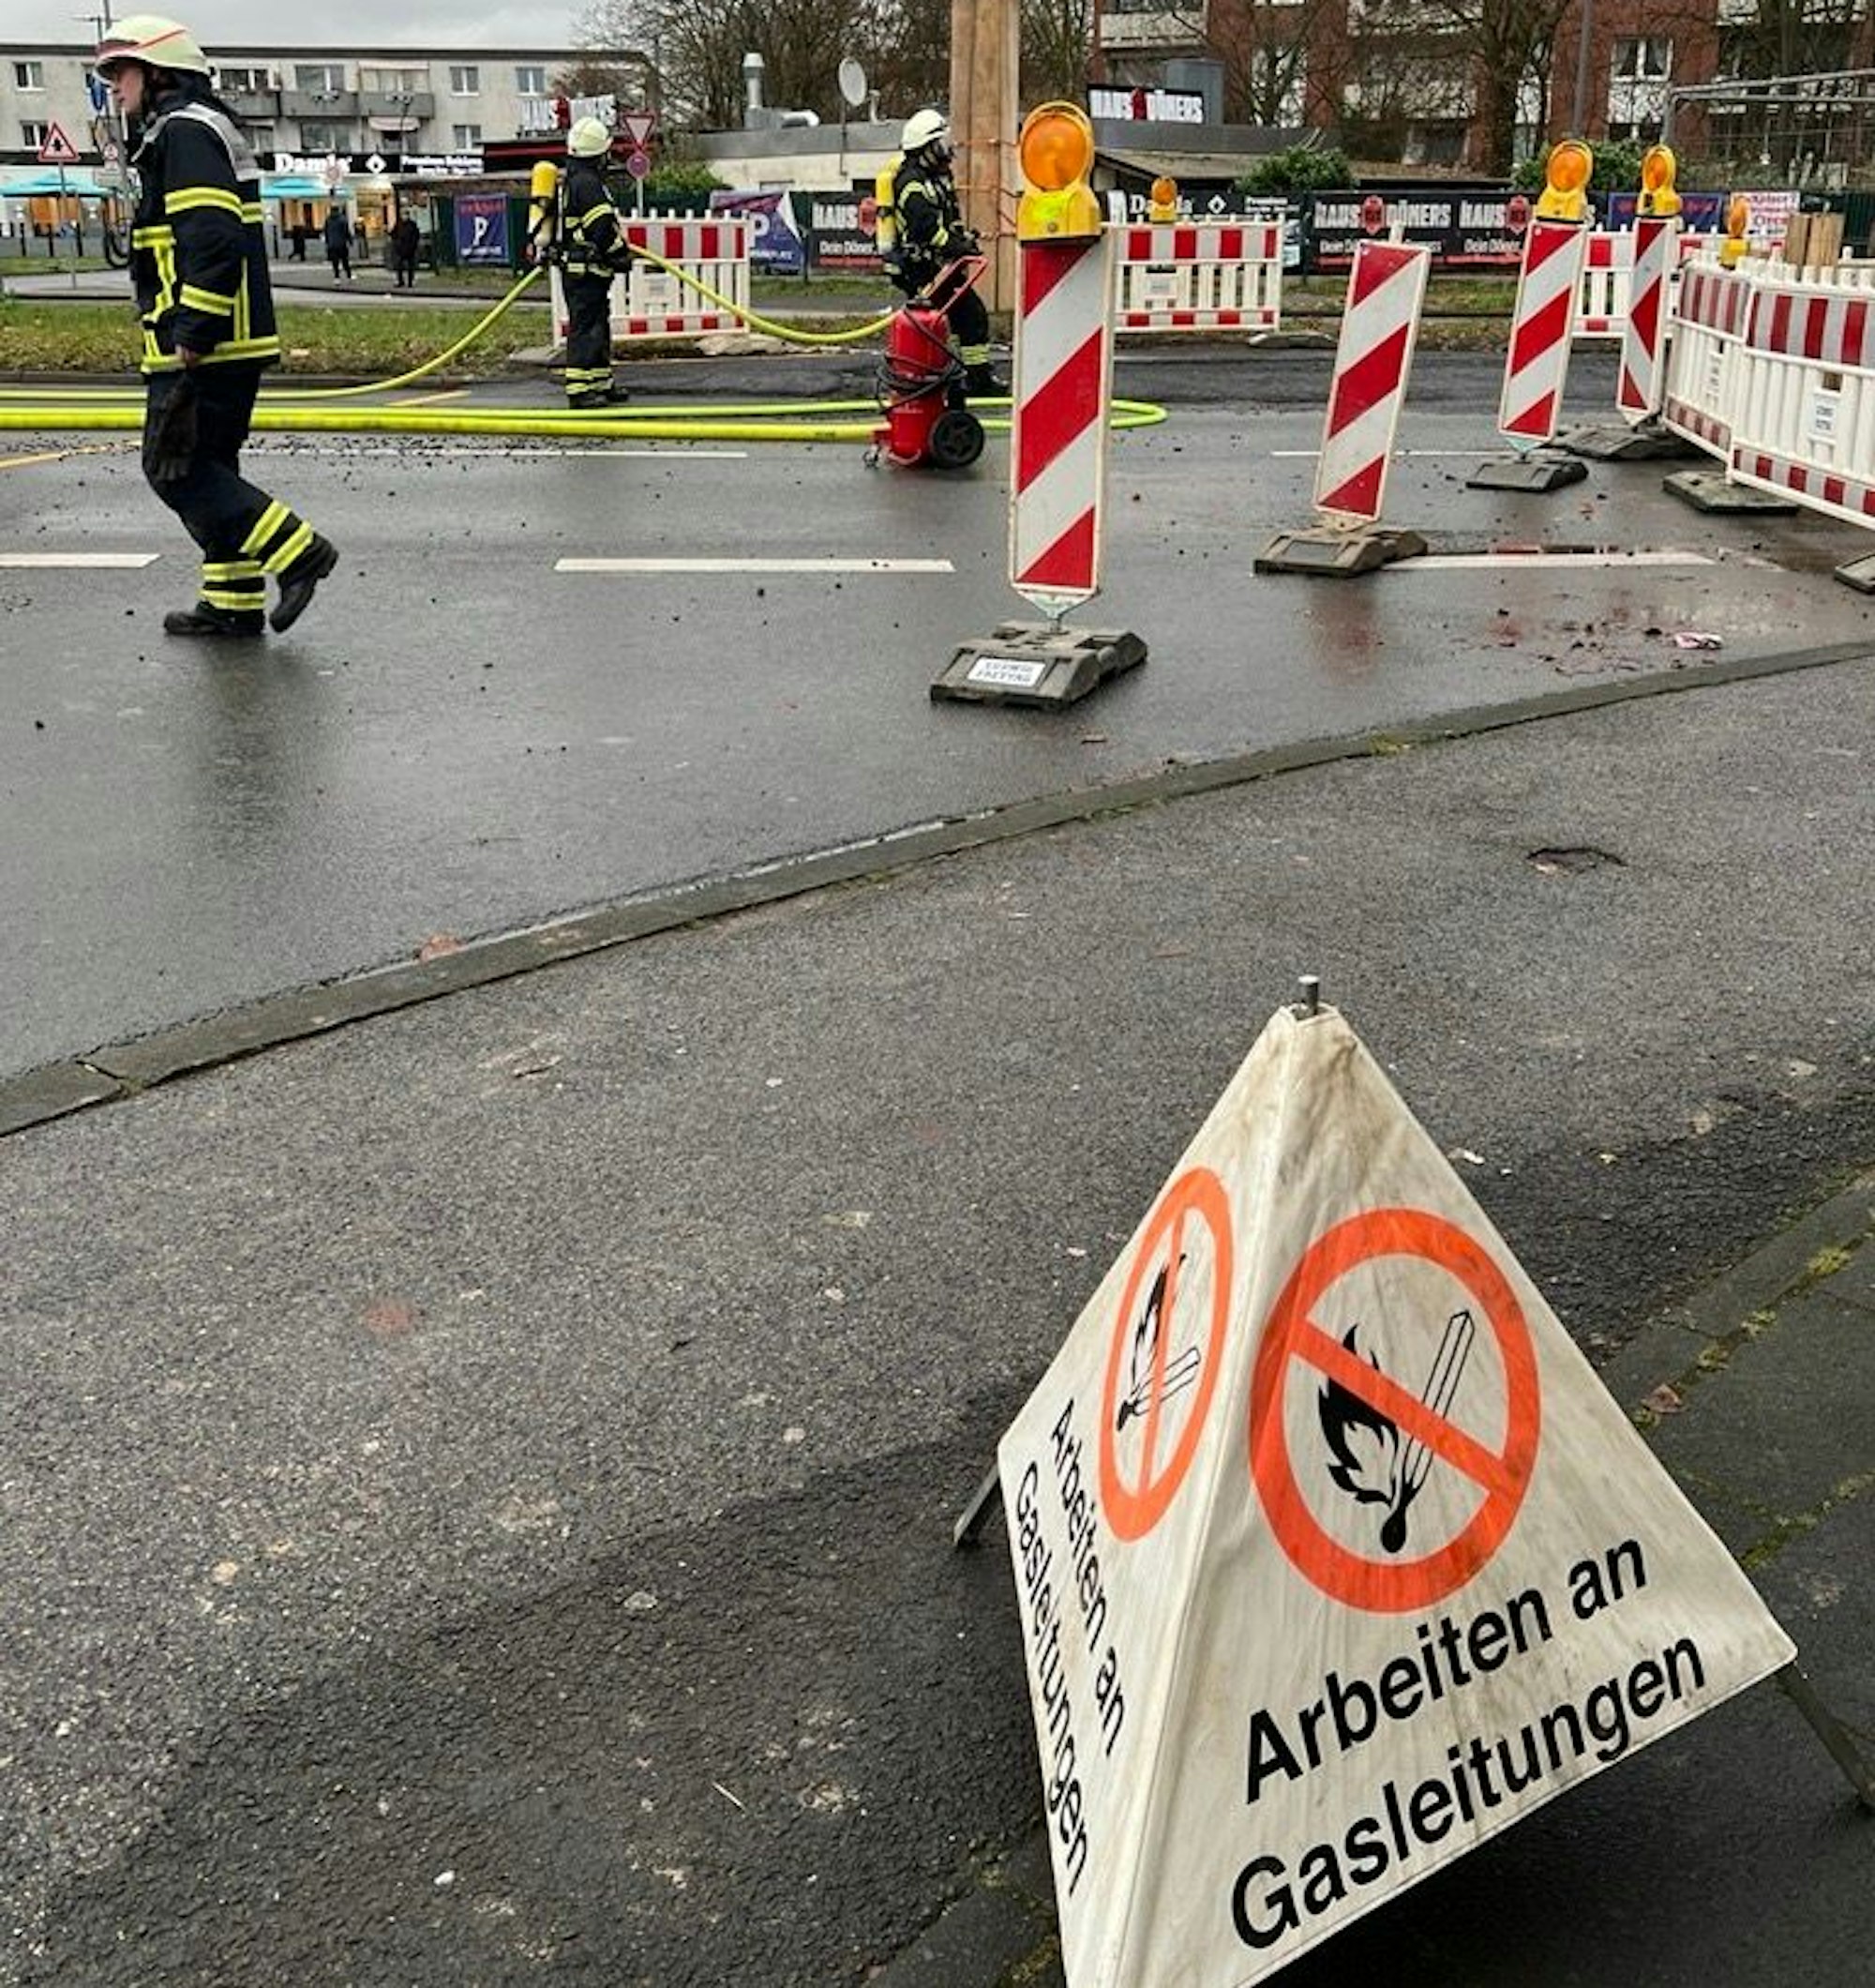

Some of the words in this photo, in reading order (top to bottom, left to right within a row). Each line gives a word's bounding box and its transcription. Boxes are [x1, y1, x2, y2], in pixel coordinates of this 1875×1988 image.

[812, 203, 858, 230] HAUS
[1314, 201, 1361, 229] HAUS
[1385, 199, 1452, 229] DÖNERS
[1459, 200, 1506, 229] HAUS
[1016, 1461, 1088, 1896] Gasleitungen
[1051, 1398, 1106, 1651] Arbeiten
[1096, 1646, 1124, 1757] an
[1245, 1590, 1554, 1804] Arbeiten
[1570, 1537, 1647, 1620] an
[1231, 1637, 1706, 1950] Gasleitungen
